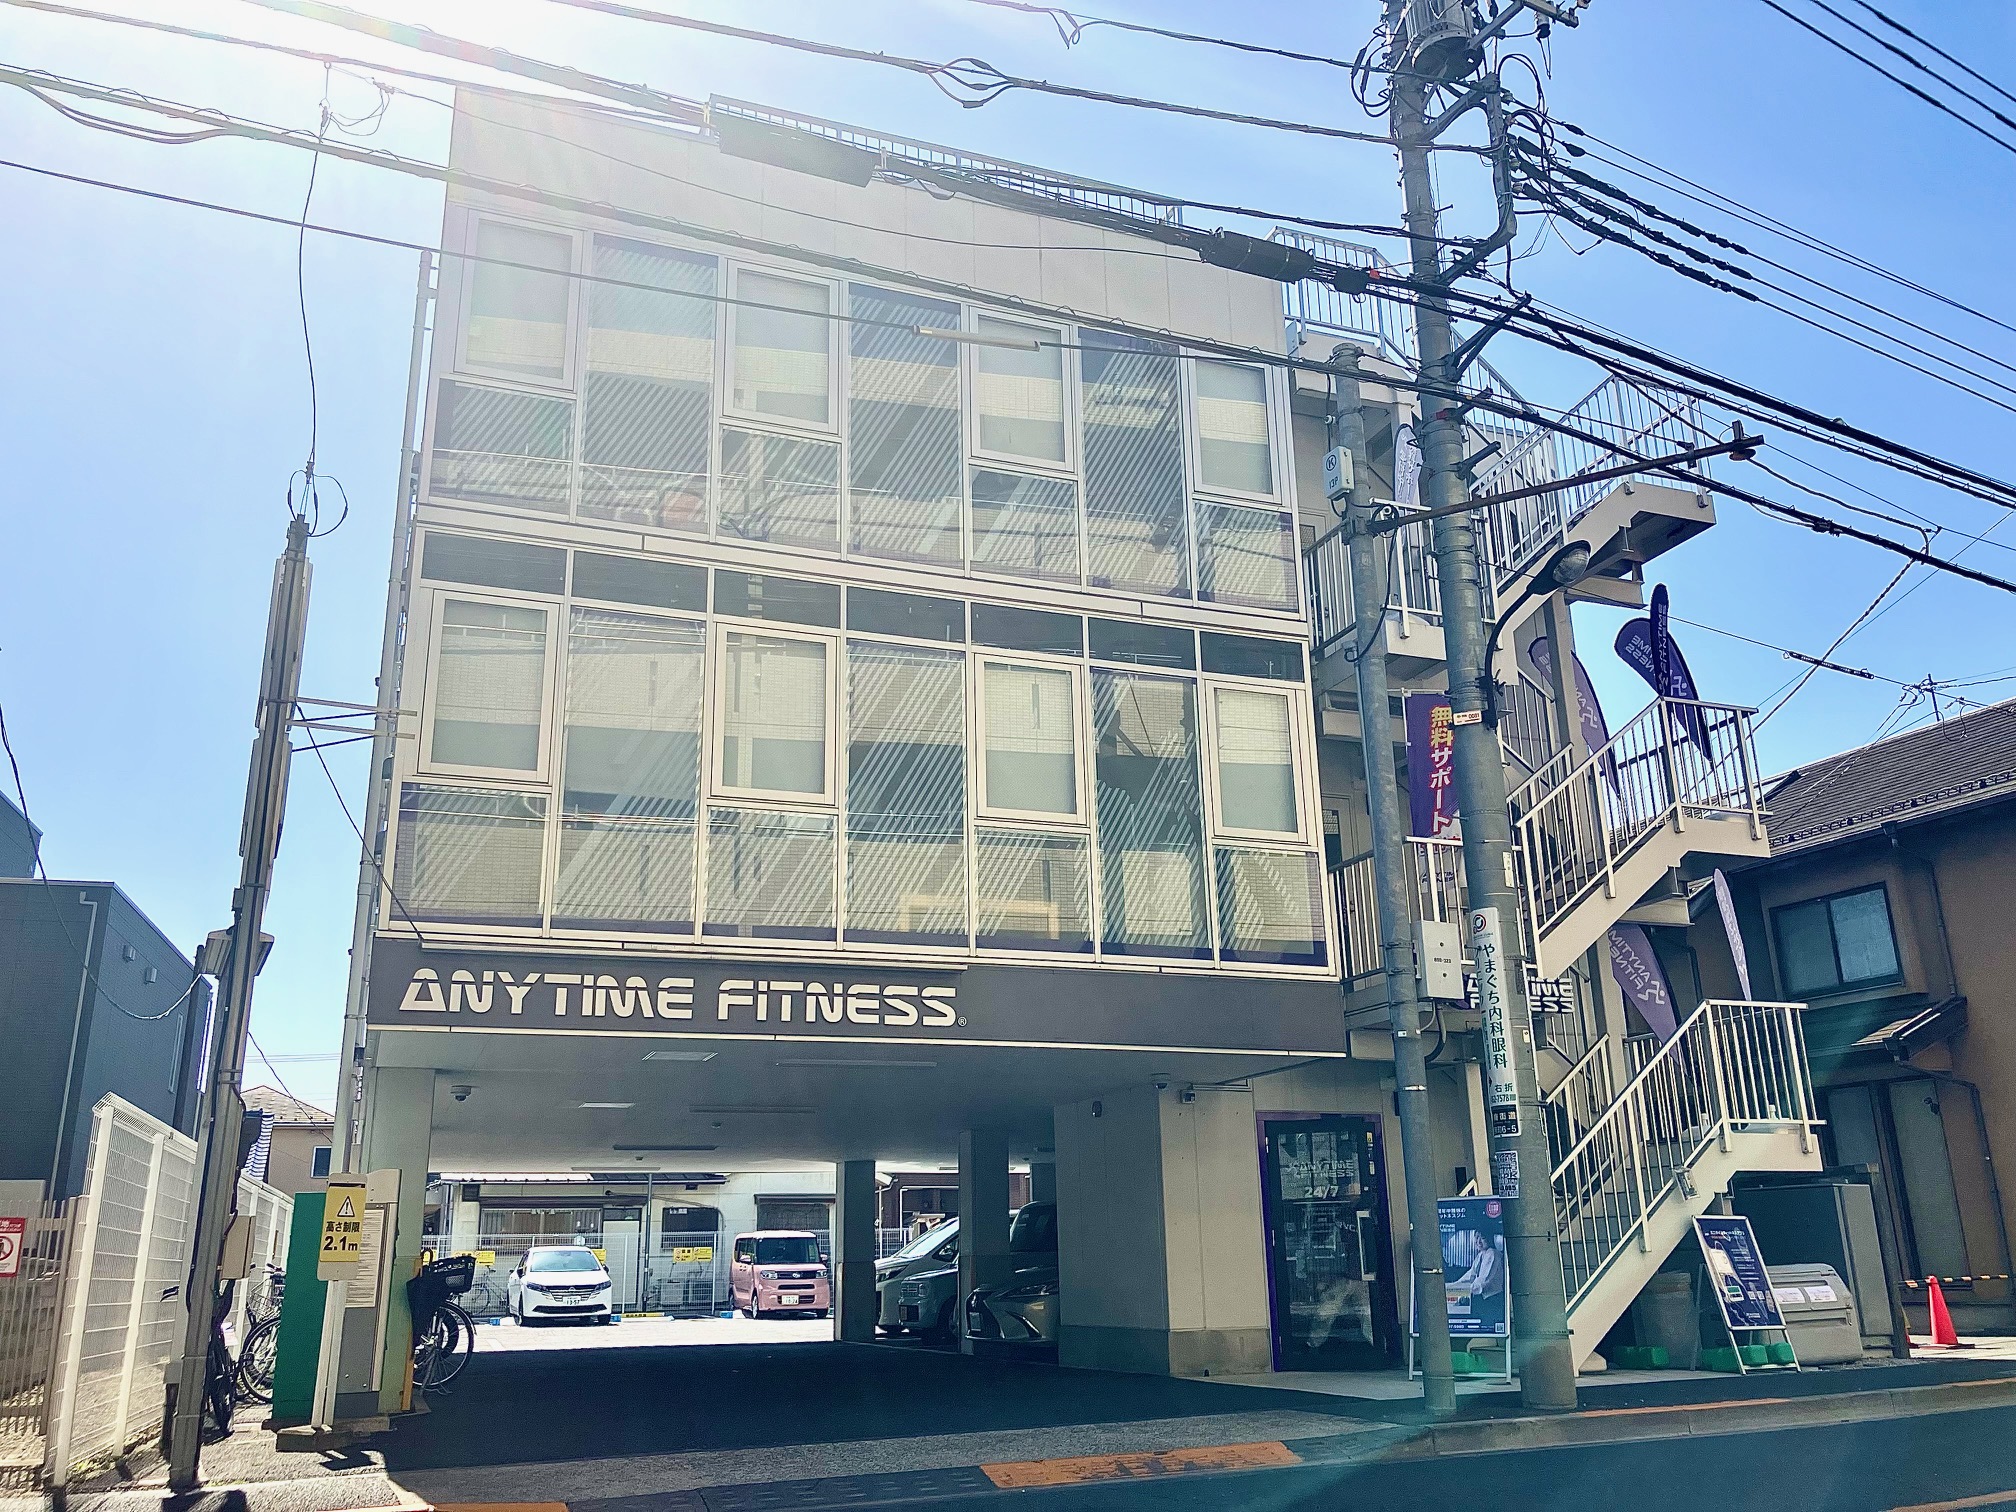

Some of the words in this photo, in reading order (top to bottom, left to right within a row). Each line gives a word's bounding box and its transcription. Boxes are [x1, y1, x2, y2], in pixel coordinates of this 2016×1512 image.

[1430, 706, 1454, 833] 無料サポート
[399, 968, 693, 1019] ANYTIME
[717, 979, 958, 1028] FITNESS
[1483, 942, 1508, 1069] やまぐち内科眼科
[1495, 1083, 1513, 1092] 右折
[1305, 1184, 1339, 1199] 24/7
[325, 1221, 361, 1233] 高さ制限
[323, 1236, 358, 1251] 2.1m
